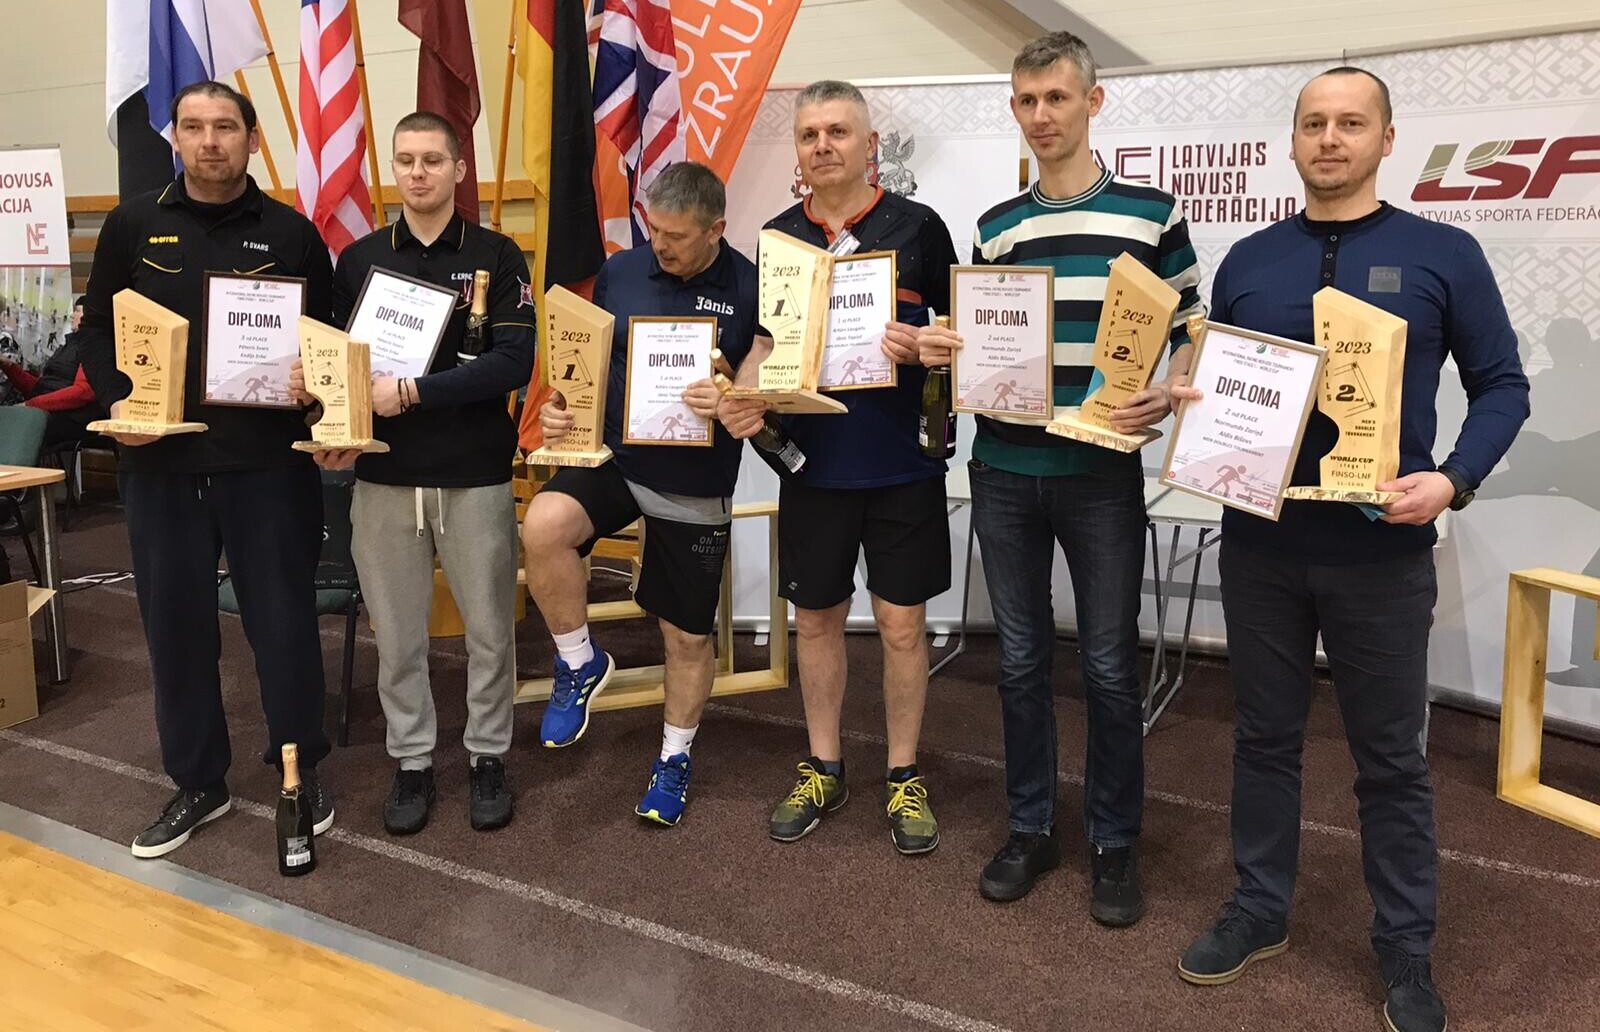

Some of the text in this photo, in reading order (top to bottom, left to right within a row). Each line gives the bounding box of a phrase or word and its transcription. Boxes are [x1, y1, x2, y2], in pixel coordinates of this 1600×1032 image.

[684, 0, 776, 159] ZRAU
[1172, 141, 1267, 169] LATVIJAS
[0, 172, 53, 189] OVUSA
[1172, 171, 1247, 196] NOVUSA
[0, 198, 32, 213] CIJA
[1475, 206, 1533, 222] SPORTA
[1536, 203, 1600, 222] FEDERĀ
[772, 265, 801, 278] 2023
[228, 311, 282, 329] DIPLOMA
[376, 305, 425, 332] DIPLOMA
[975, 308, 1029, 328] DIPLOMA
[1120, 307, 1154, 327] 2023
[133, 323, 159, 336] 2023
[560, 330, 591, 344] 2023
[316, 348, 339, 359] 2023
[1335, 340, 1373, 355] 2023
[648, 353, 696, 368] DIPLOMA
[1214, 375, 1282, 410] DIPLOMA
